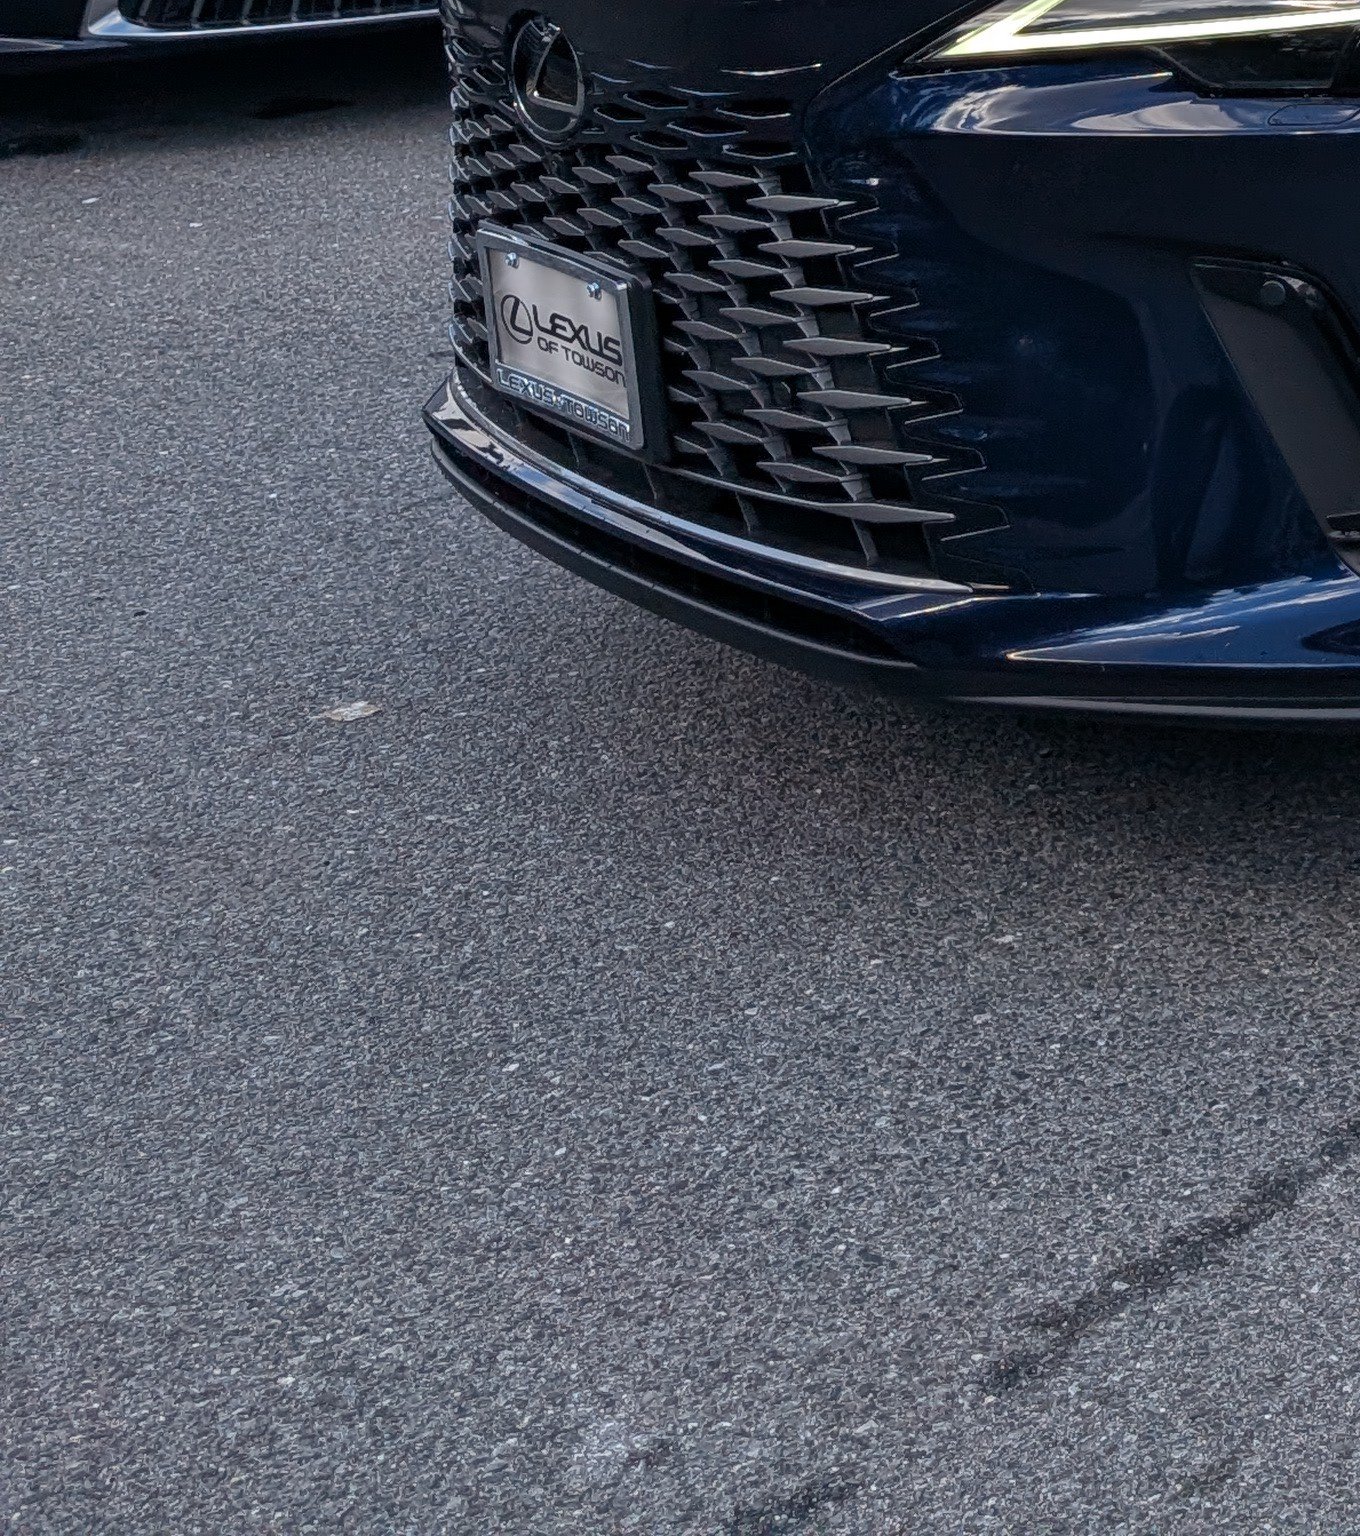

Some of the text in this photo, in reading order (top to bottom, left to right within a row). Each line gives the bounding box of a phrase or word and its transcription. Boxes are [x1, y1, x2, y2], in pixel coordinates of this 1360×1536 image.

[531, 303, 623, 366] LEXUS
[537, 336, 627, 388] OF TOWSON
[496, 367, 630, 443] LEXUS TOWSON
